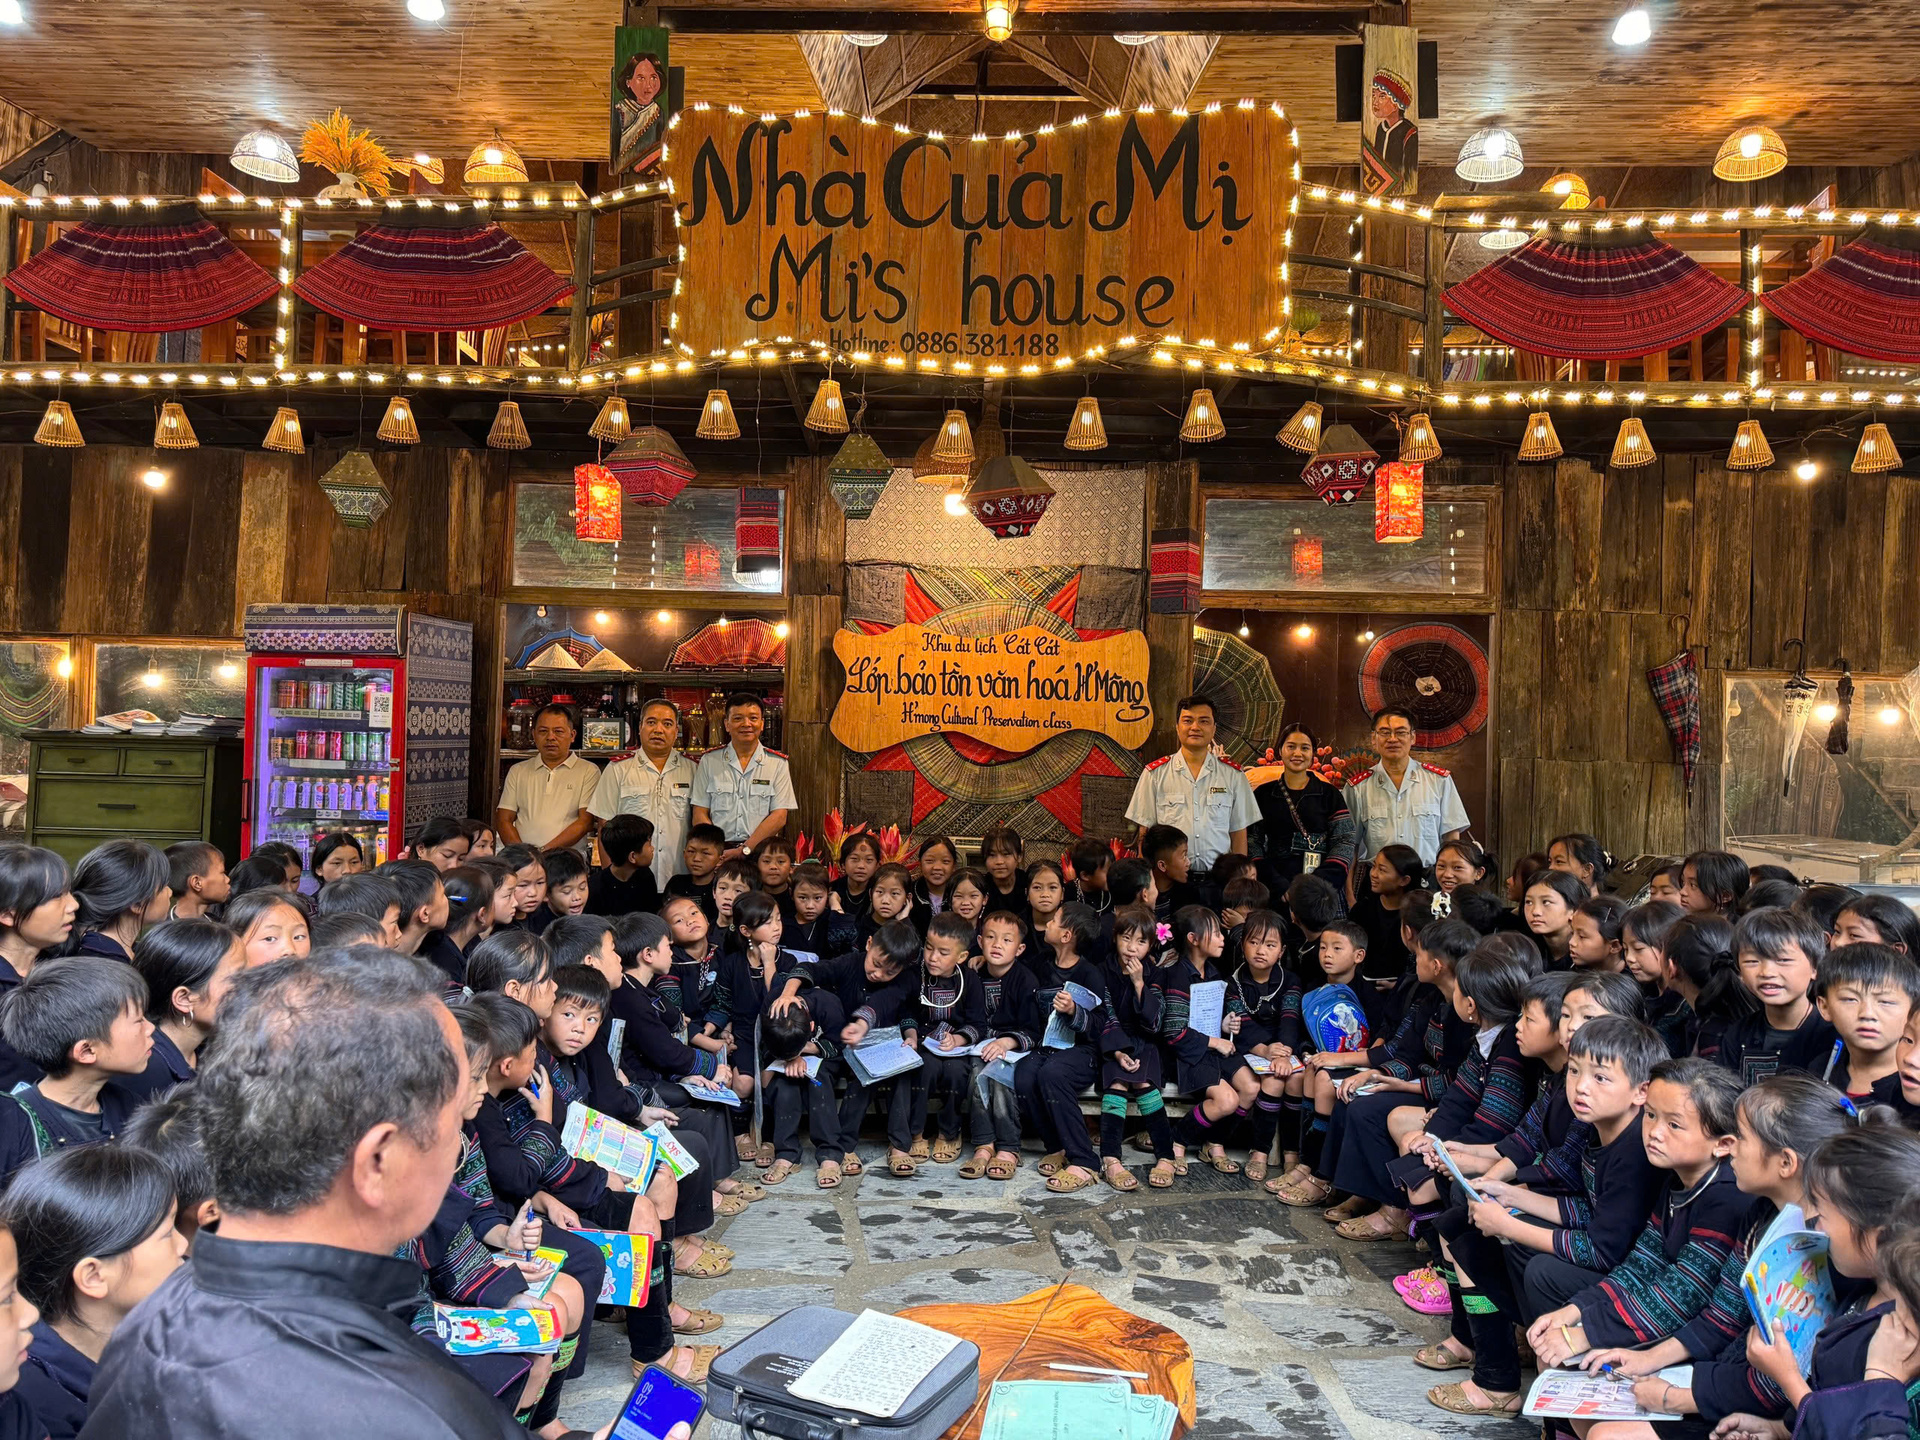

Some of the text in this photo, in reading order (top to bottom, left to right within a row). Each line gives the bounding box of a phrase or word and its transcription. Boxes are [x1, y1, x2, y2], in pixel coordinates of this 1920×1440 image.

[677, 119, 874, 229] Nhà
[1089, 113, 1254, 245] Mị
[745, 232, 1175, 329] Mi's house
[829, 328, 1060, 356] Hotline: 0886.381.188
[922, 632, 1061, 656] Khu du lịch Cát Cát
[846, 654, 1150, 723] Lớp bảo tồn văn hoá H'Mông
[901, 701, 1072, 732] H'mong Cultural Preservation class
[664, 1138, 681, 1157] sky
[635, 1393, 648, 1406] 07
[641, 1382, 654, 1396] 09
